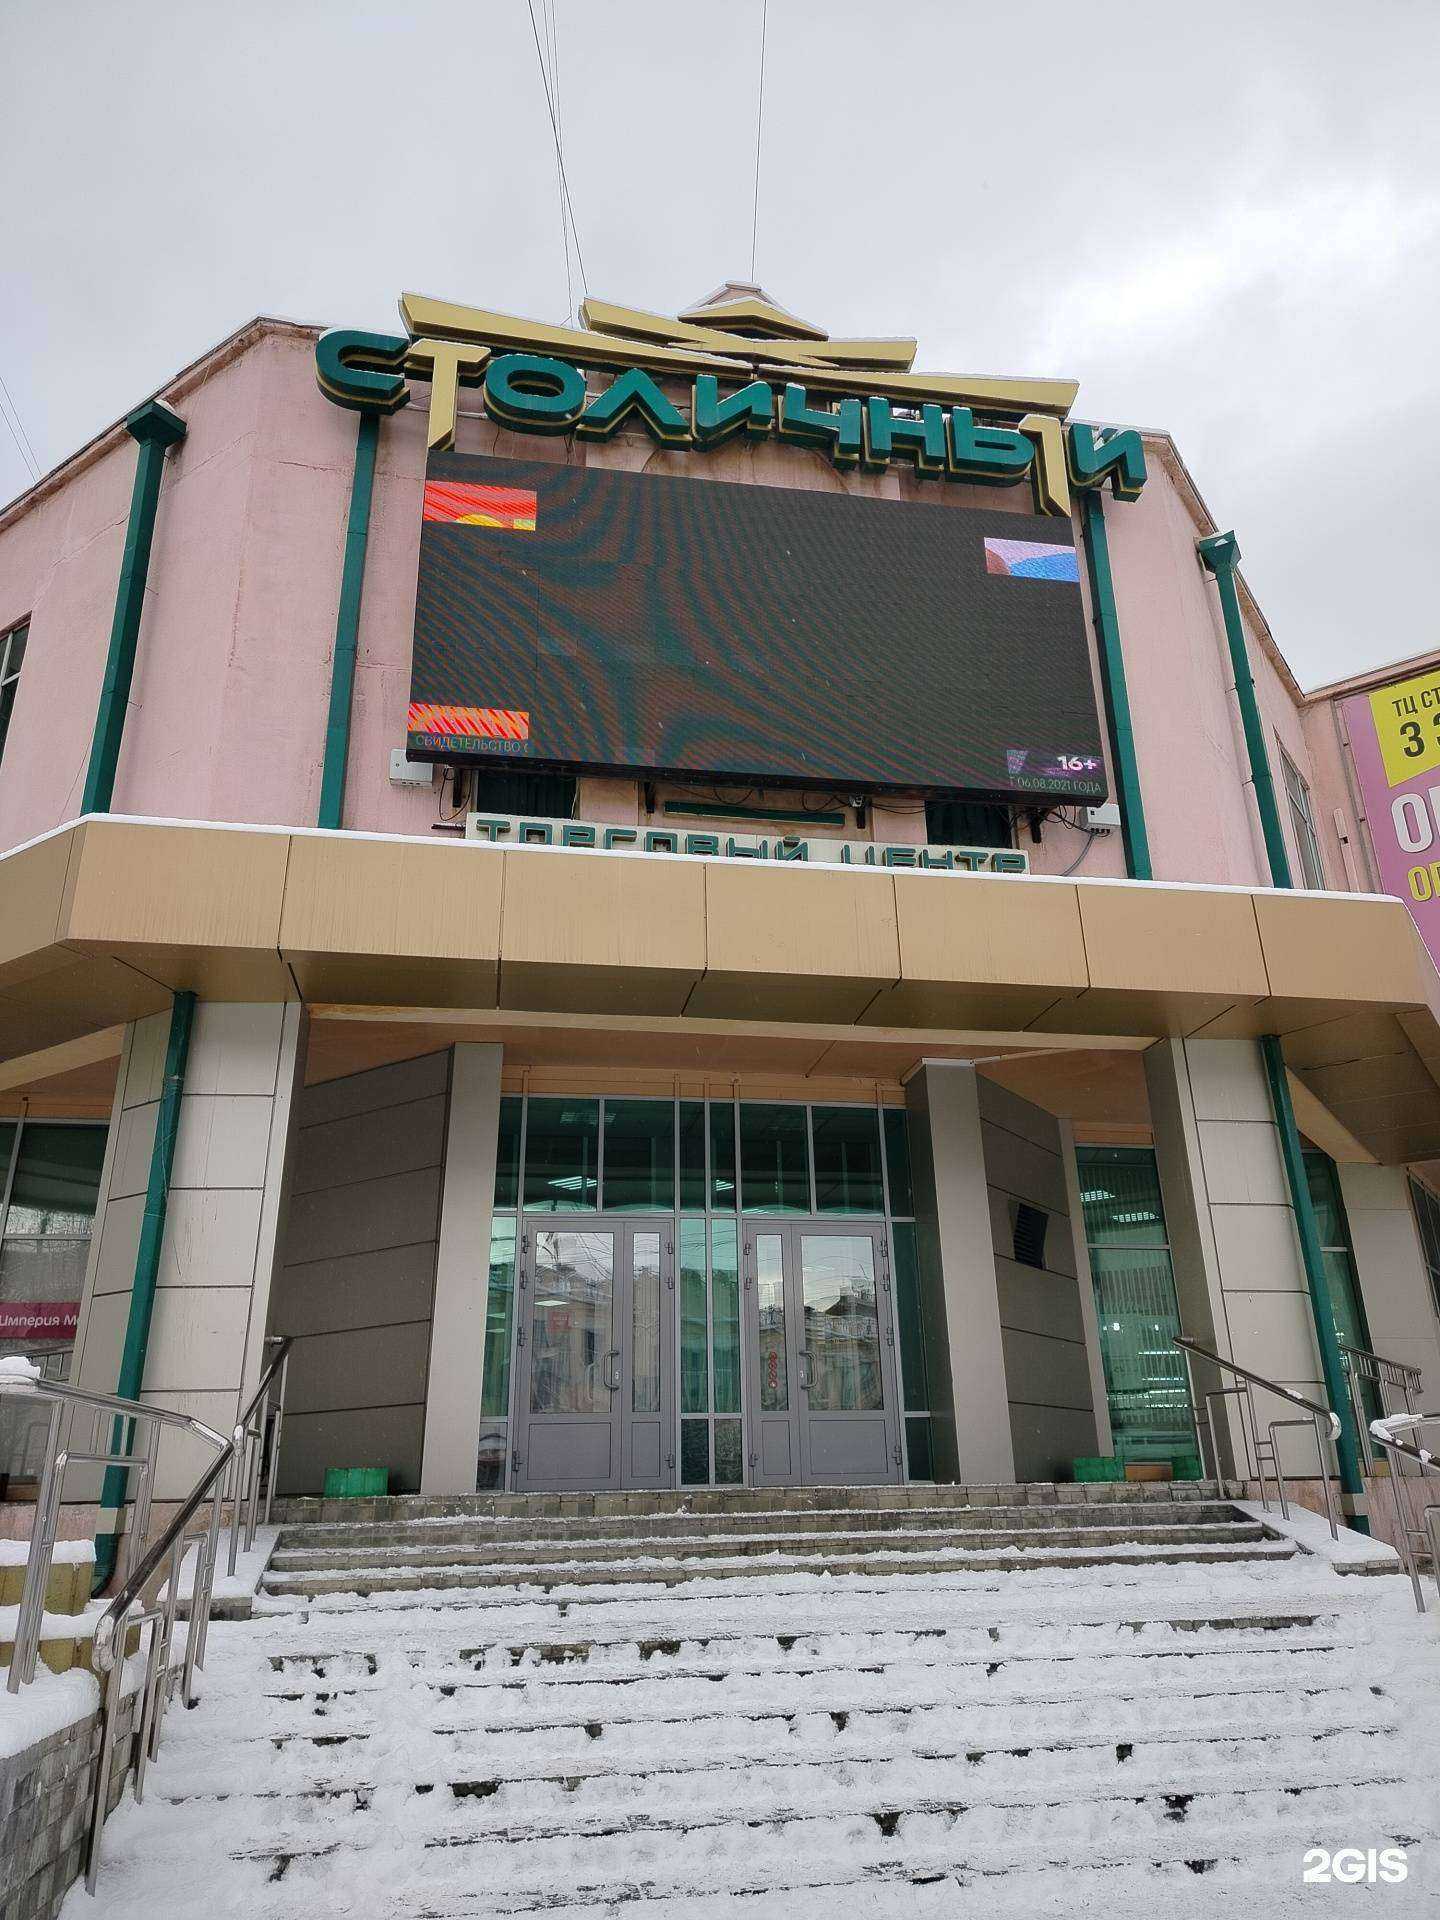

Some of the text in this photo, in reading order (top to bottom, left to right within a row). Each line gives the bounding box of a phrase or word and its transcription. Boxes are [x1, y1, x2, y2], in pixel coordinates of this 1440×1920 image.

[1392, 695, 1418, 717] ТЦ
[1057, 755, 1096, 770] 16+
[1017, 777, 1071, 791] 06.08.2021
[1073, 781, 1101, 794] ГОДА
[1391, 786, 1440, 853] О
[0, 1313, 77, 1328] Империя М
